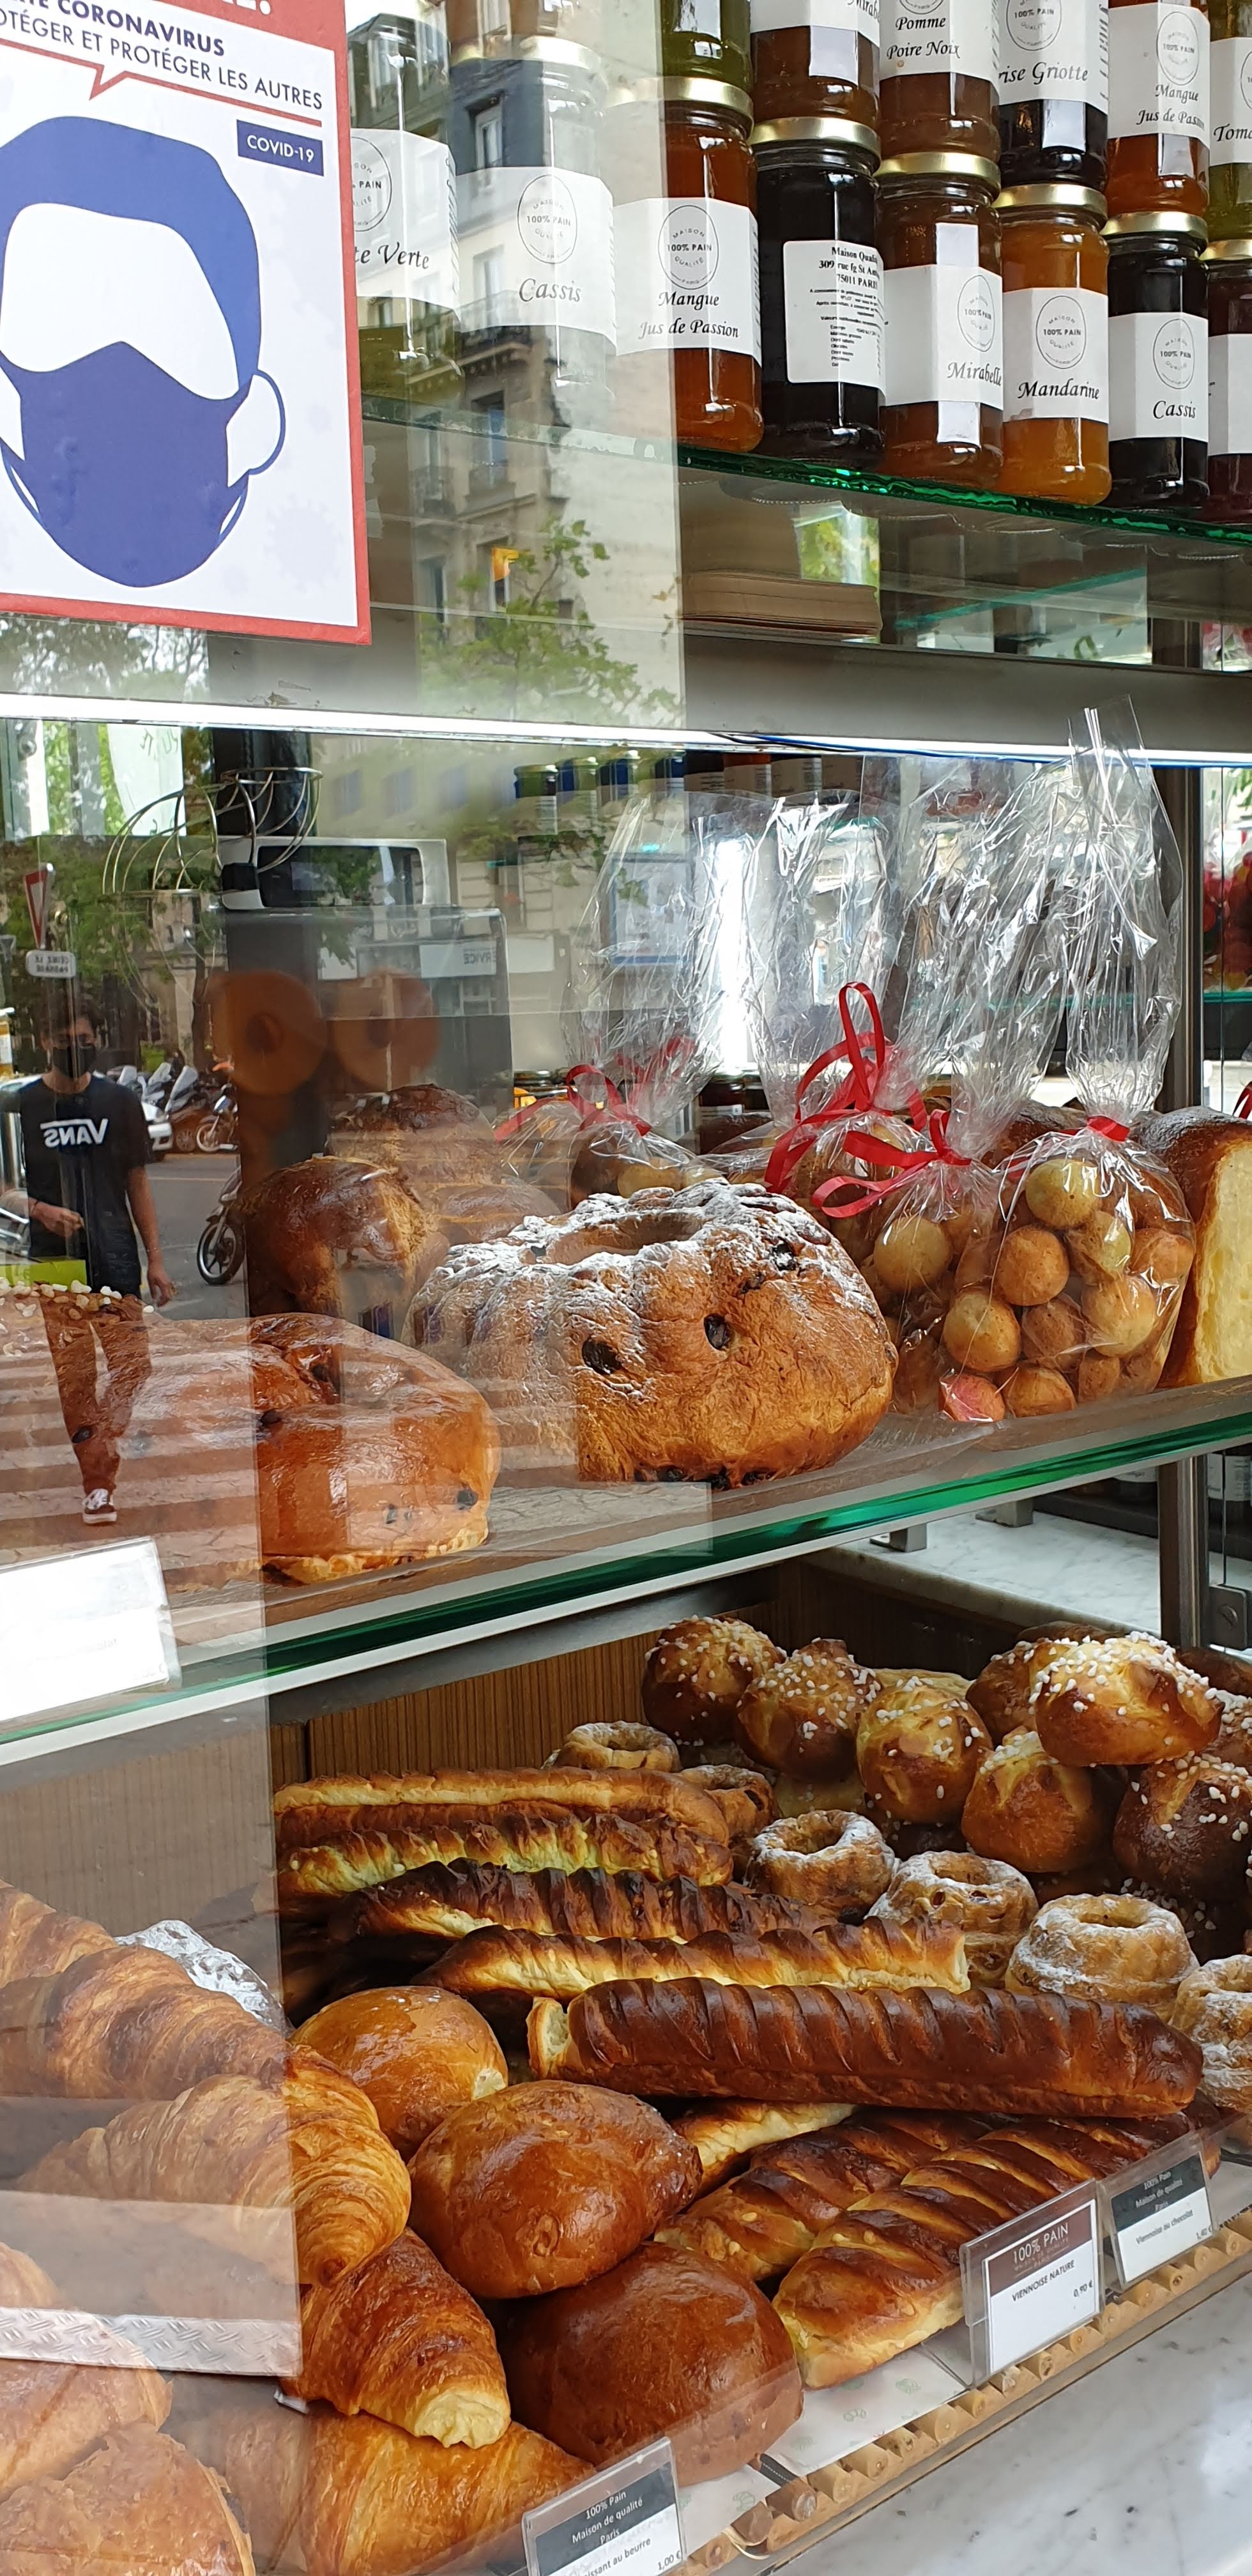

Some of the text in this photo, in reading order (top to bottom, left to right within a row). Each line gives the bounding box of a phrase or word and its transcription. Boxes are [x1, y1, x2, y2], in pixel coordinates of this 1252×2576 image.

[896, 17, 946, 31] Pomme
[1014, 9, 1035, 19] 100%
[58, 0, 224, 56] CORONAVIRUS
[886, 40, 960, 60] Poire Noix
[82, 30, 102, 52] ET
[111, 38, 211, 82] PROTÉGER
[218, 66, 248, 90] LES
[255, 77, 323, 109] AUTRES
[1032, 61, 1088, 85] Griotte
[1155, 84, 1200, 104] Mangue
[1136, 109, 1159, 125] Jus
[1163, 107, 1175, 122] de
[247, 135, 315, 162] COVID-19
[359, 180, 382, 189] PAIN
[527, 215, 571, 227] 100% PAIN
[673, 227, 705, 238] MAISON
[378, 241, 429, 269] Verte
[832, 247, 857, 258] Maison
[818, 260, 835, 269] 309
[837, 273, 855, 285] 75011
[519, 277, 581, 303] Cassis
[658, 291, 720, 311] Mangue
[637, 317, 739, 339] Jus de Passion
[1018, 378, 1100, 400] Mandarine
[1152, 400, 1196, 419] Cassis
[1013, 2222, 1069, 2264] 100% PAIN
[1012, 2259, 1075, 2302] VIENNOISE NATURE
[586, 2491, 627, 2520] 100% Pain
[572, 2496, 643, 2544] Maison de qualité
[600, 2527, 621, 2545] Paris
[584, 2538, 652, 2576] issant au beurre
[657, 2554, 675, 2571] 1,00
